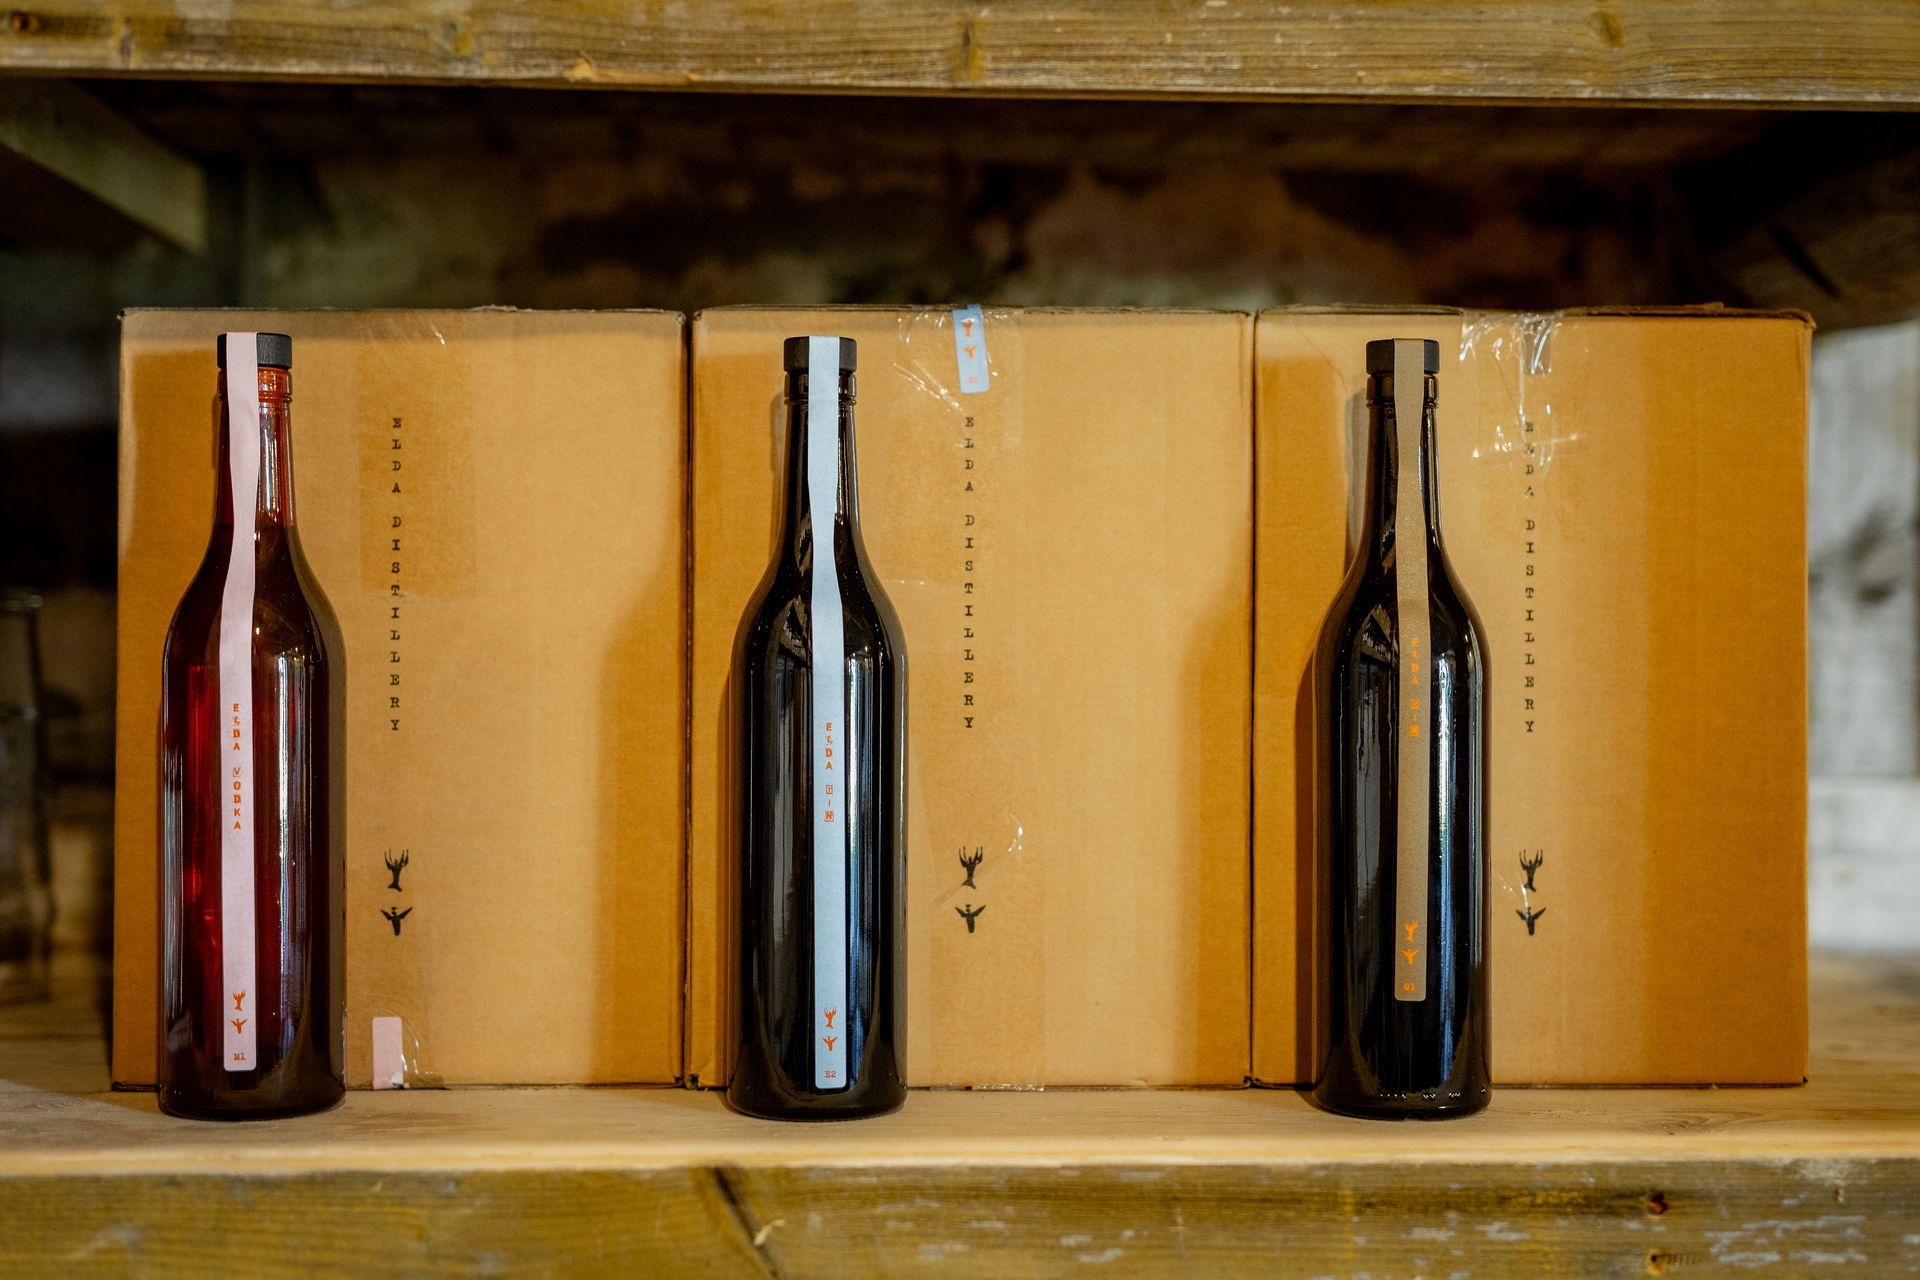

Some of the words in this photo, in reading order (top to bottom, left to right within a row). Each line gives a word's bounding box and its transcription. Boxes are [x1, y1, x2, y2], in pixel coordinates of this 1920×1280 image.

[391, 417, 402, 494] ELDA
[964, 416, 975, 492] ELDA
[389, 516, 402, 731] DISTILLERY
[963, 515, 975, 729] DISTILLERY
[1524, 519, 1536, 733] DISTILLERY
[232, 702, 242, 752] ELDA
[825, 721, 833, 772] ELDA
[232, 767, 242, 831] VODKA
[824, 784, 835, 823] GIN
